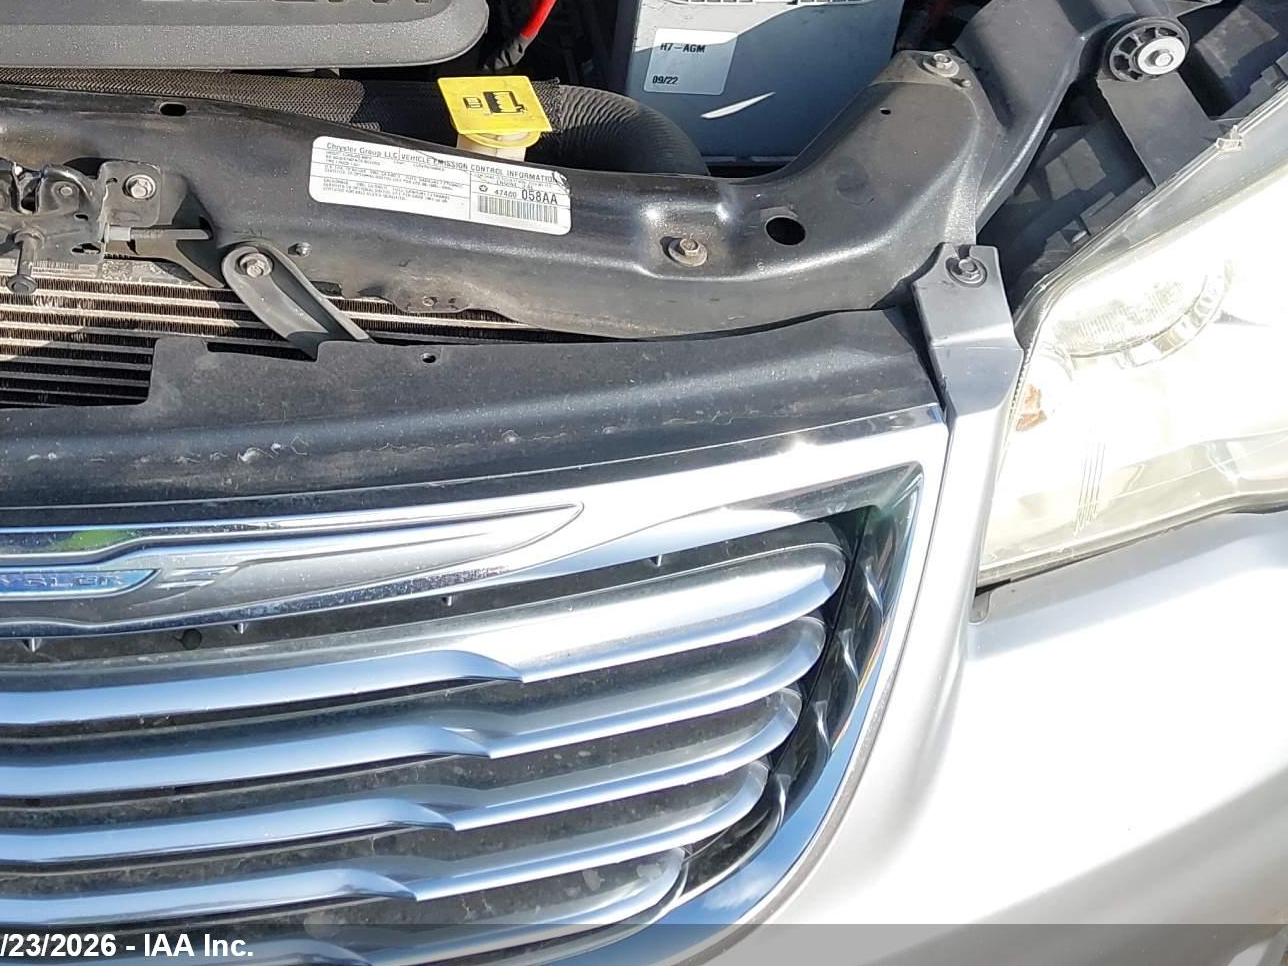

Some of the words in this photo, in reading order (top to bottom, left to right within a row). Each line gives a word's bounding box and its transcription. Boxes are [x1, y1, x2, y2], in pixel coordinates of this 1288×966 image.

[660, 43, 706, 53] H7-AGM
[652, 75, 679, 85] 09/22
[326, 142, 357, 153] Chrysler
[359, 147, 382, 157] Group
[384, 151, 398, 159] LLC
[401, 154, 431, 163] VEHICLE
[471, 164, 503, 174] CONTROL
[521, 189, 558, 205] 058AA
